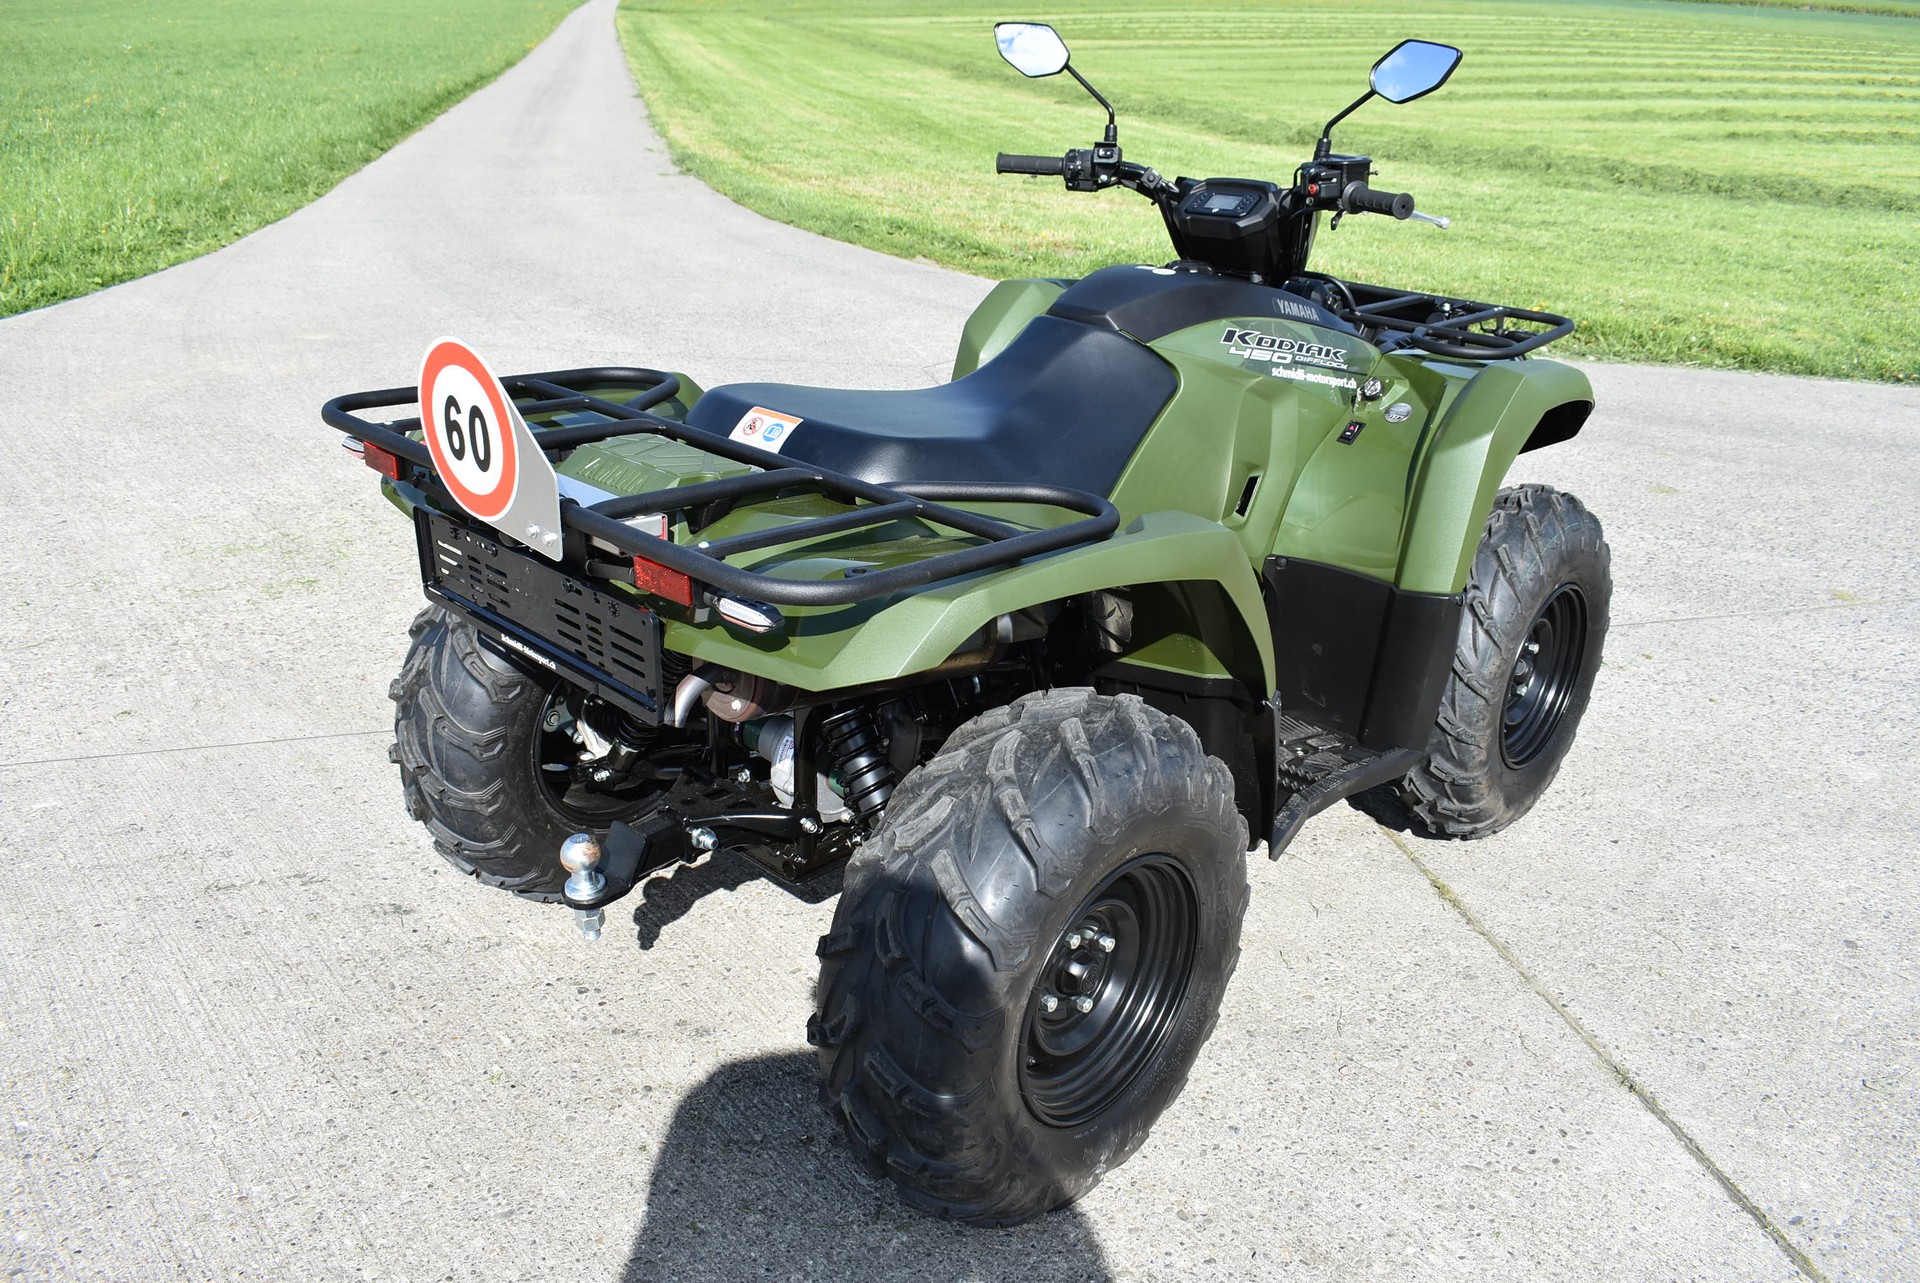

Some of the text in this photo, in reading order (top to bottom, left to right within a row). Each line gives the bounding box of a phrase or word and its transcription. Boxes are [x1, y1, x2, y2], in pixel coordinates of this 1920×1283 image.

[1276, 298, 1320, 322] YAMAHA
[1220, 327, 1347, 363] KODIAK
[1228, 346, 1349, 370] 450 DIFFLOCK
[444, 394, 491, 473] 60
